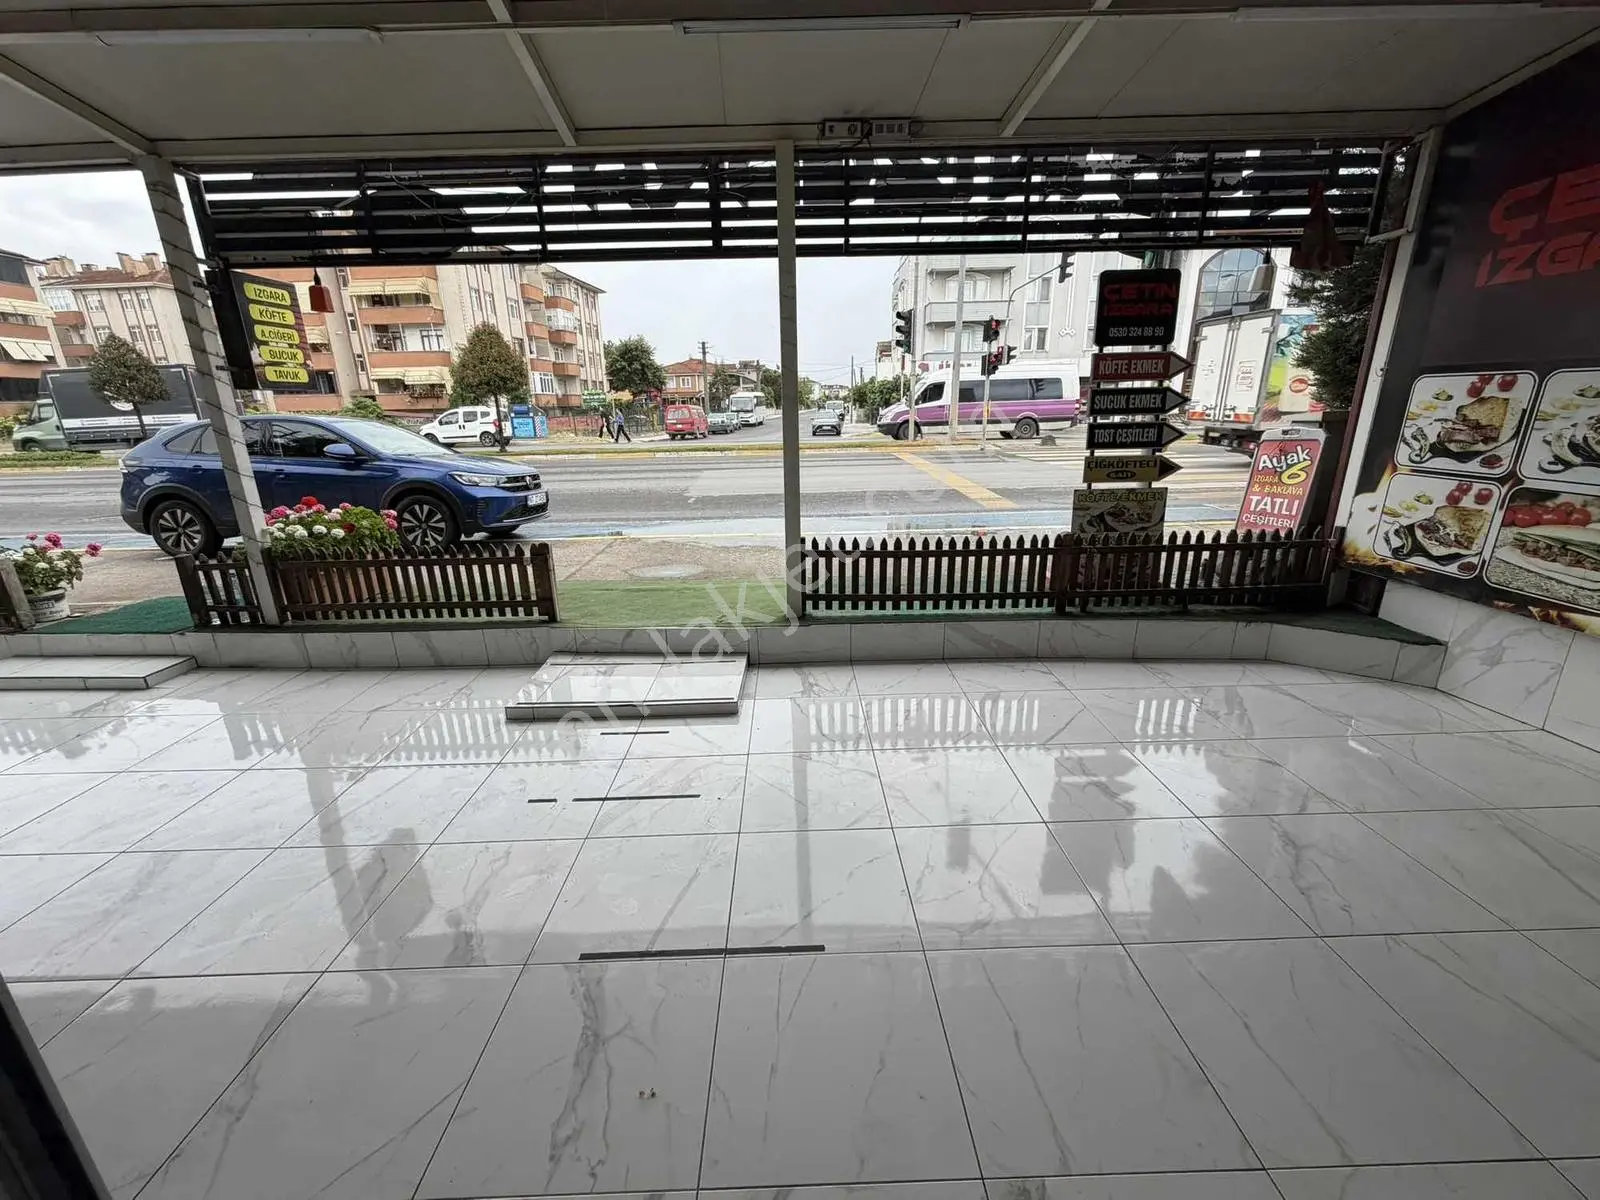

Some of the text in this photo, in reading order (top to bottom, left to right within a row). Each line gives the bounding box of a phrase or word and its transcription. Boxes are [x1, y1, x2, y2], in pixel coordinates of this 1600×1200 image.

[253, 287, 287, 303] IZGARA
[258, 308, 287, 322] KÖFTE
[1108, 327, 1128, 337] 0530
[269, 349, 299, 361] SUCUK
[1099, 357, 1164, 375] KÖFTE EKMEK
[274, 369, 302, 380] TAVUK
[1094, 393, 1163, 409] SUCUK EKMEK
[1094, 429, 1115, 443] TOST
[1258, 444, 1312, 471] Ayak
[1280, 460, 1312, 486] 6
[1264, 484, 1304, 495] BAKLAVA
[1249, 495, 1300, 516] TATLI
